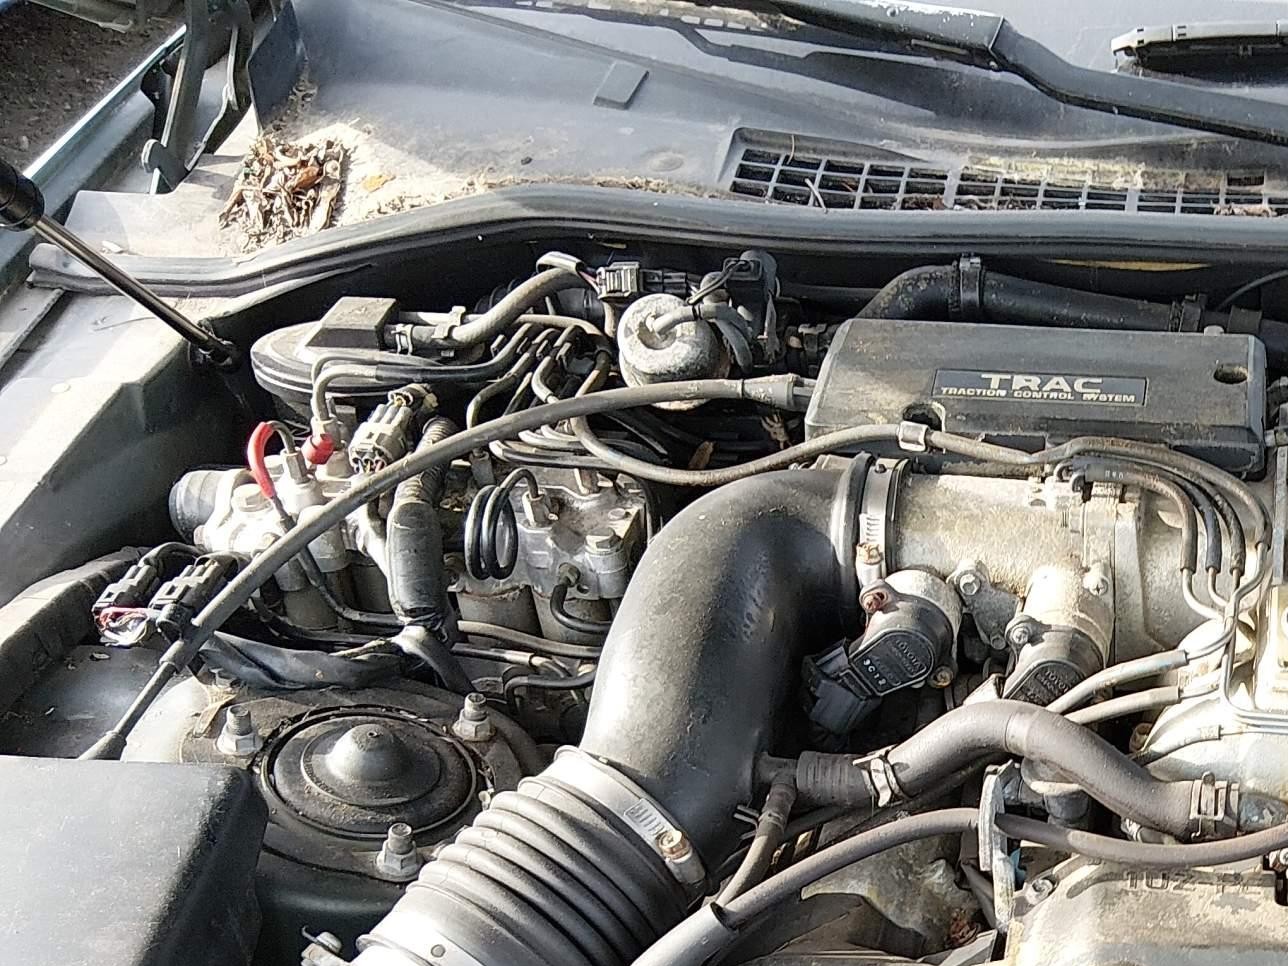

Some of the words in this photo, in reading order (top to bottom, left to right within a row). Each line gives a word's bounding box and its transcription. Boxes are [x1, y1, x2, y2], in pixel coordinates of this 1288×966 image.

[980, 373, 1103, 394] TRAC
[941, 387, 1007, 397] TRACTION
[1013, 390, 1075, 400] CONTROL
[1082, 393, 1135, 403] SYSTEM
